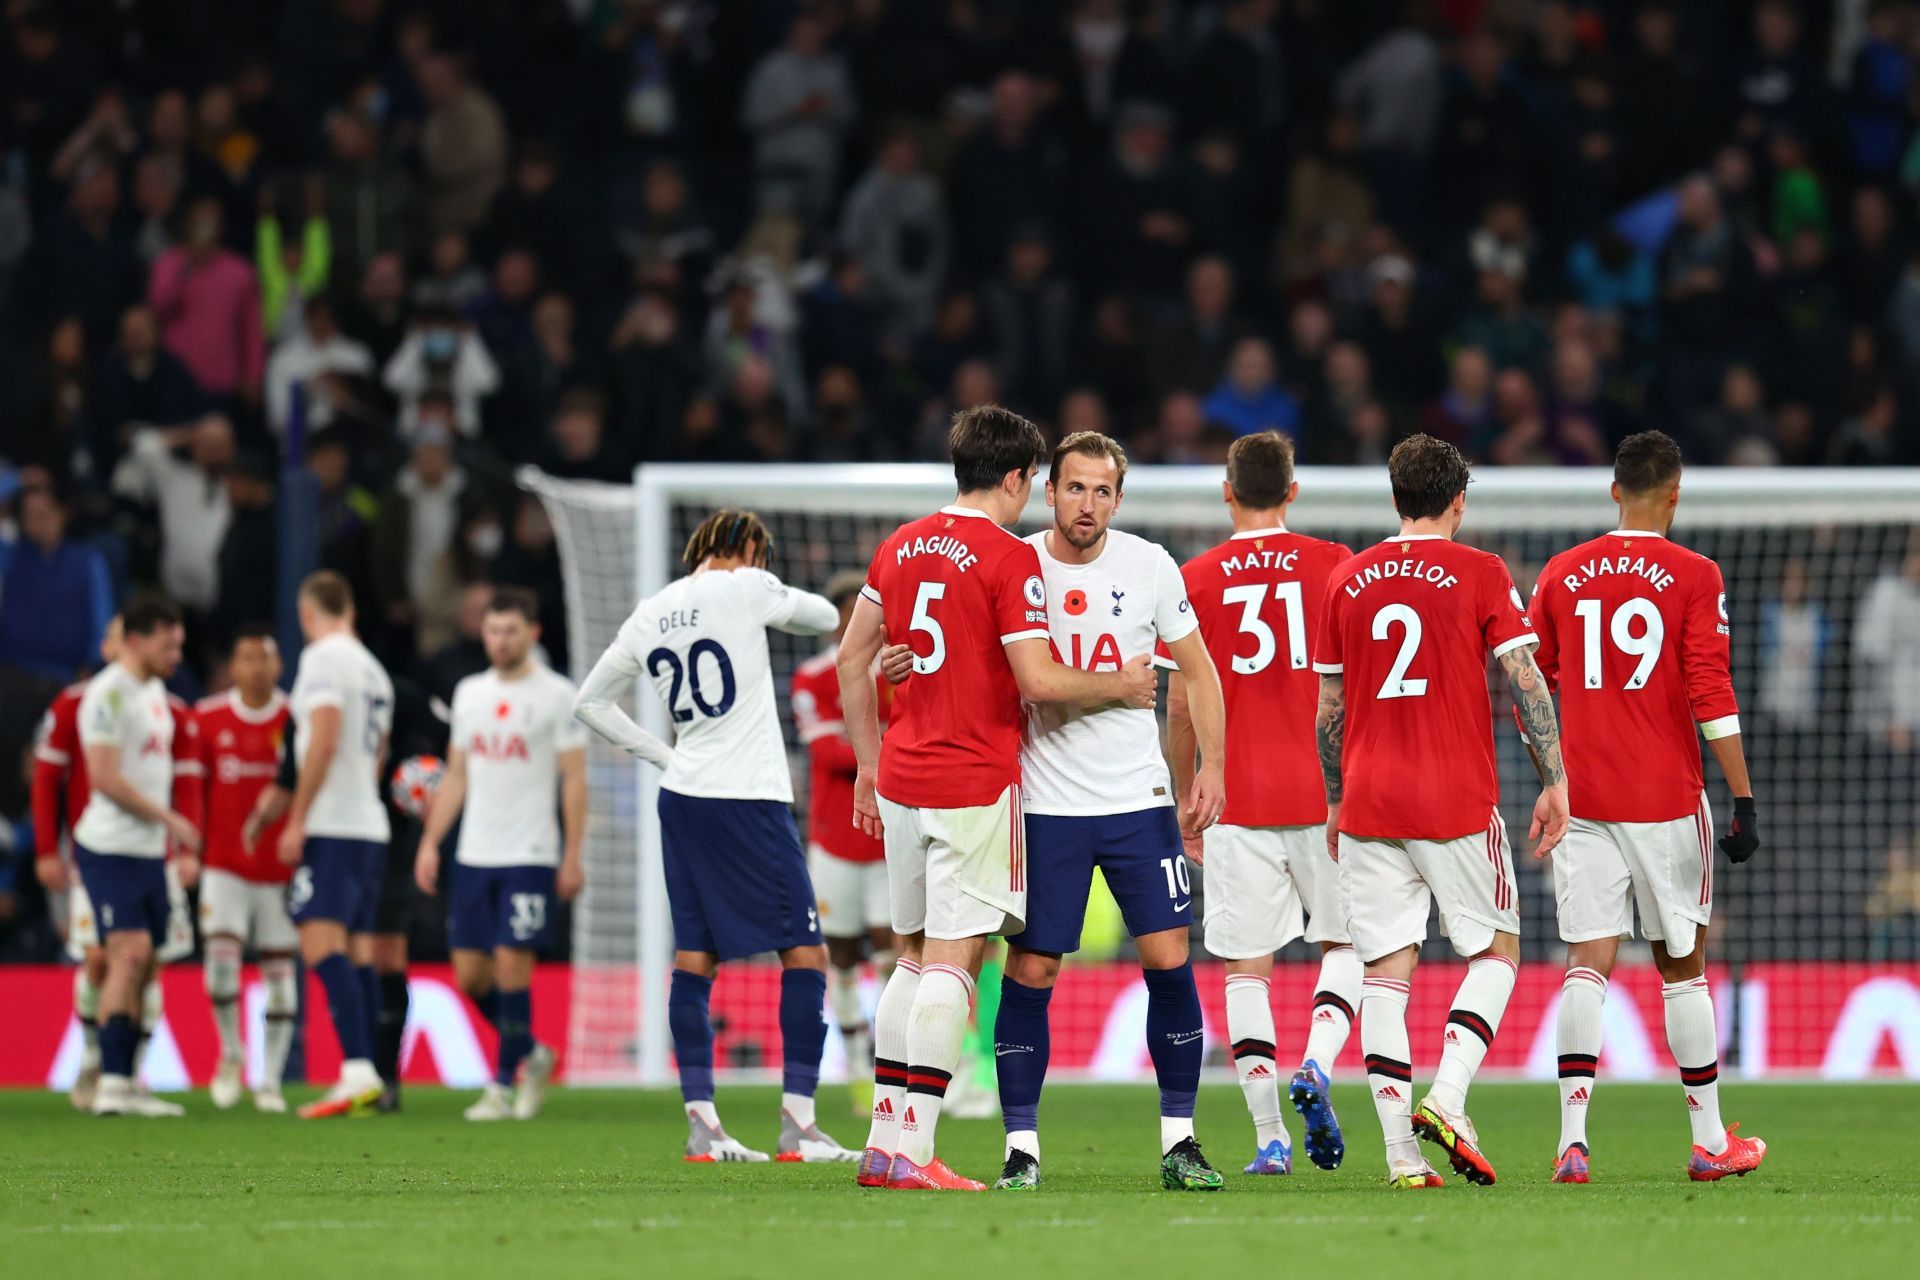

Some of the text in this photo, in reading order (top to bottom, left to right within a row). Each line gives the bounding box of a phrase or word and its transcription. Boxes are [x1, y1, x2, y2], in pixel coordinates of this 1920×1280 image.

[896, 535, 978, 573] MAGUIRE
[1220, 549, 1299, 577] MATIĆ
[1563, 556, 1675, 593] R.VARANE
[1345, 559, 1458, 599] LINDELOF
[659, 609, 700, 635] DELE
[909, 581, 946, 675] 5
[1222, 581, 1308, 675] 31
[1574, 597, 1665, 690] 19
[1371, 603, 1428, 700] 2
[646, 638, 737, 723] 20
[1160, 854, 1191, 899] 10
